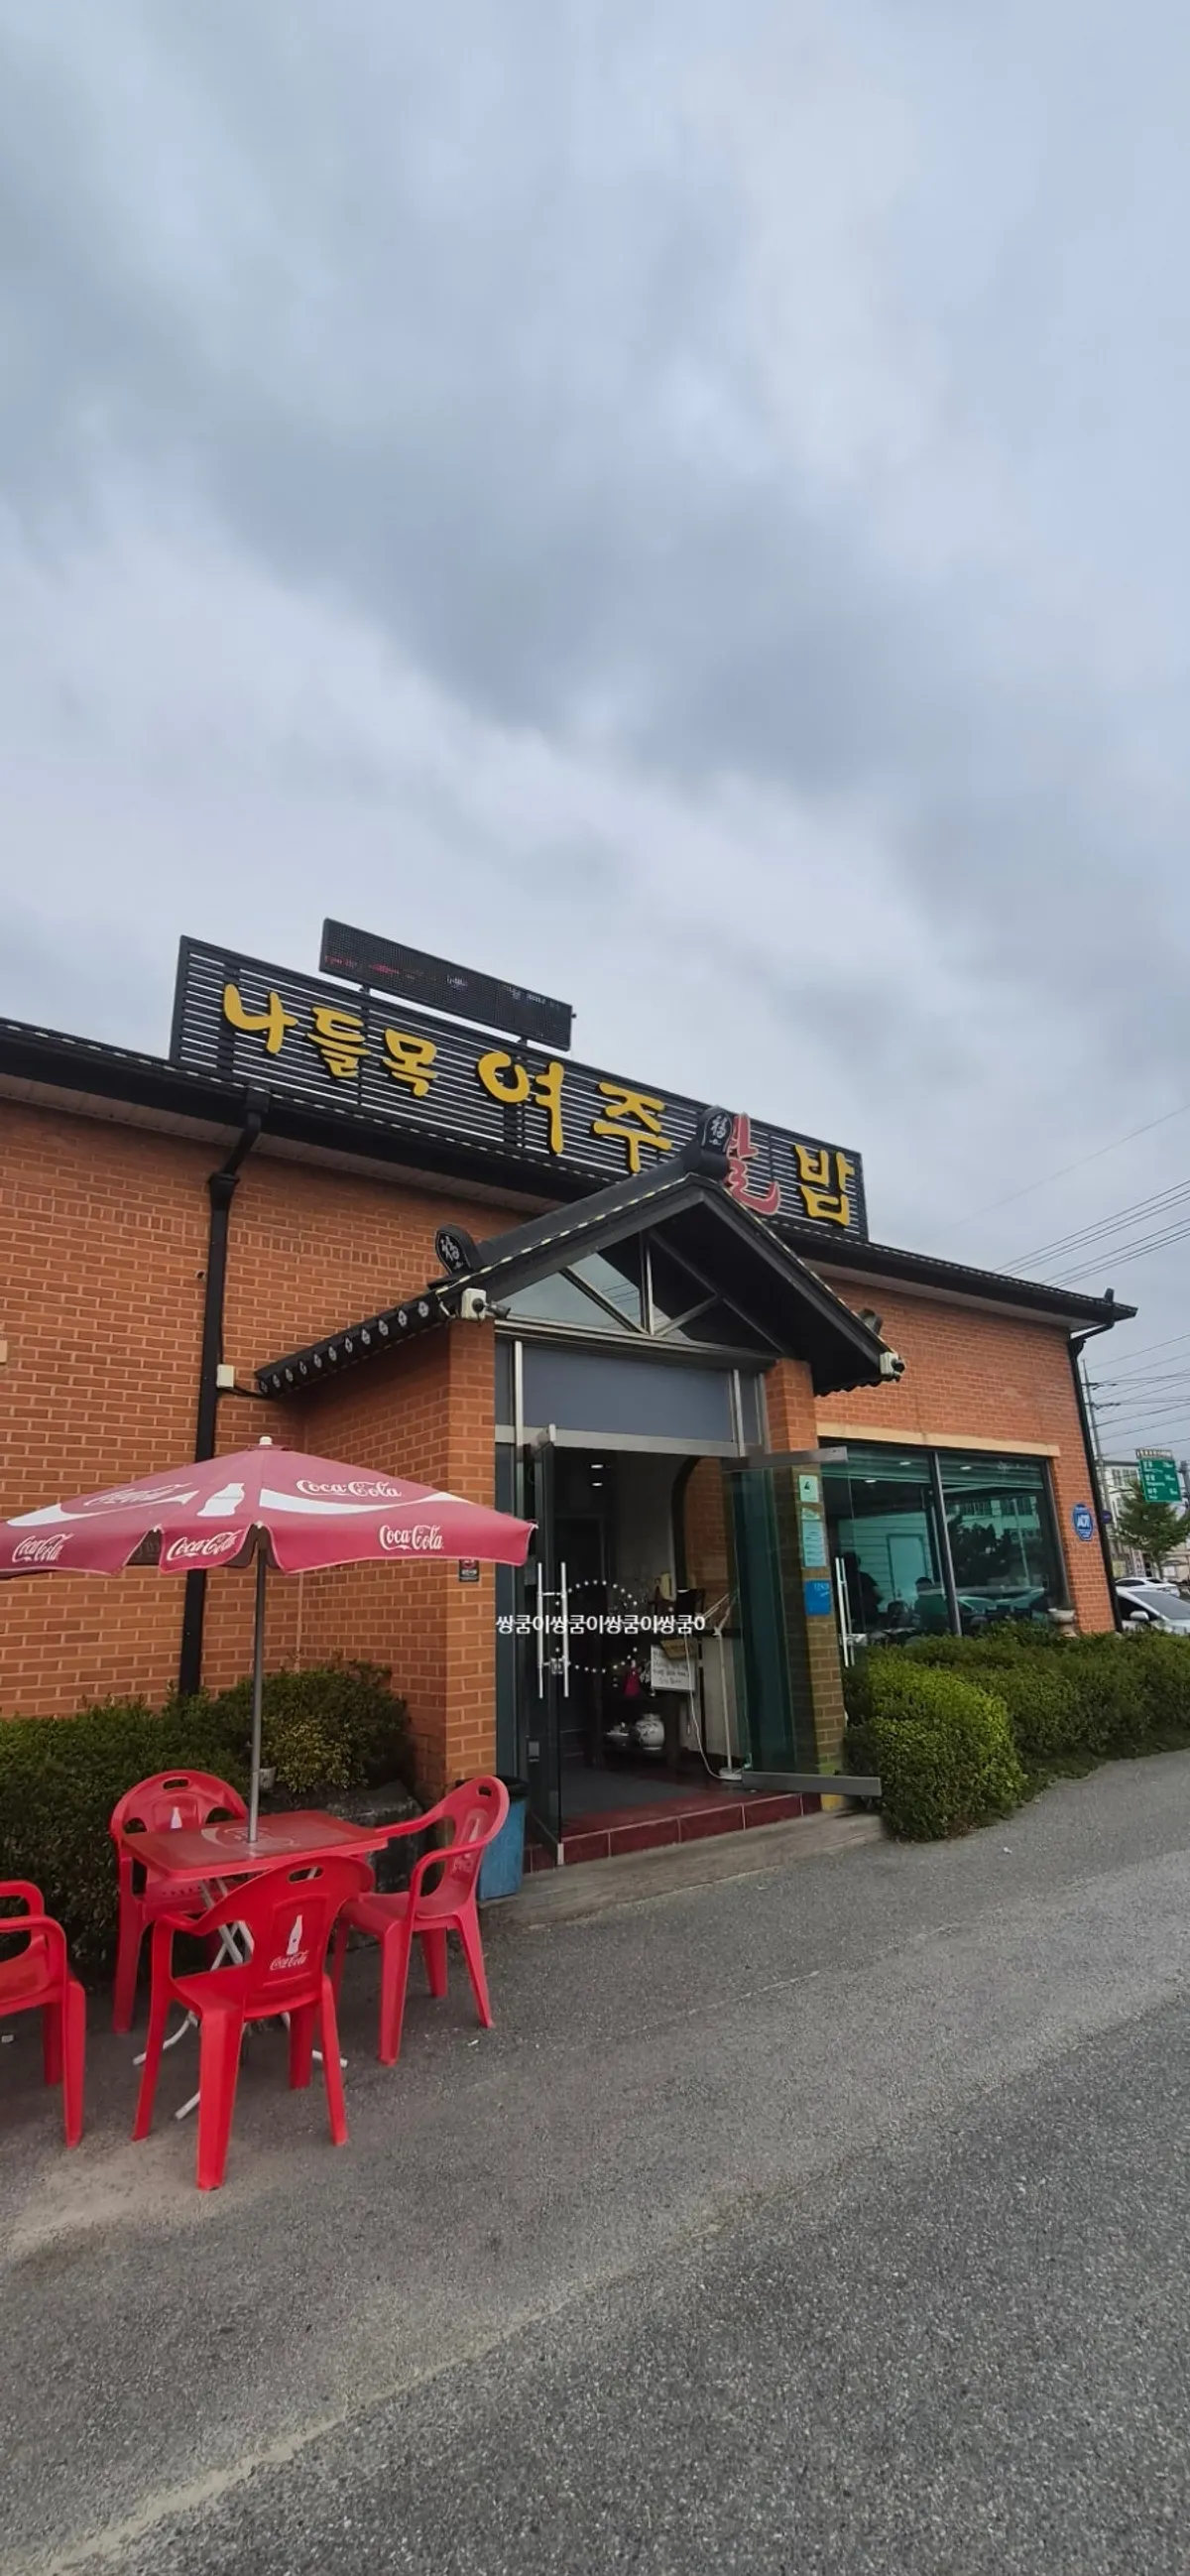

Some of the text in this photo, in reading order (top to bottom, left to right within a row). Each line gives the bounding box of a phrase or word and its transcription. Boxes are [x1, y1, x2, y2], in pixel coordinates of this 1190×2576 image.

[223, 983, 438, 1097] 나들목
[297, 1479, 402, 1498] Coca-Cola
[12, 1533, 74, 1563] Coca-Cola
[167, 1529, 245, 1561] Coca-Cola
[379, 1525, 445, 1560] Coca-Cola
